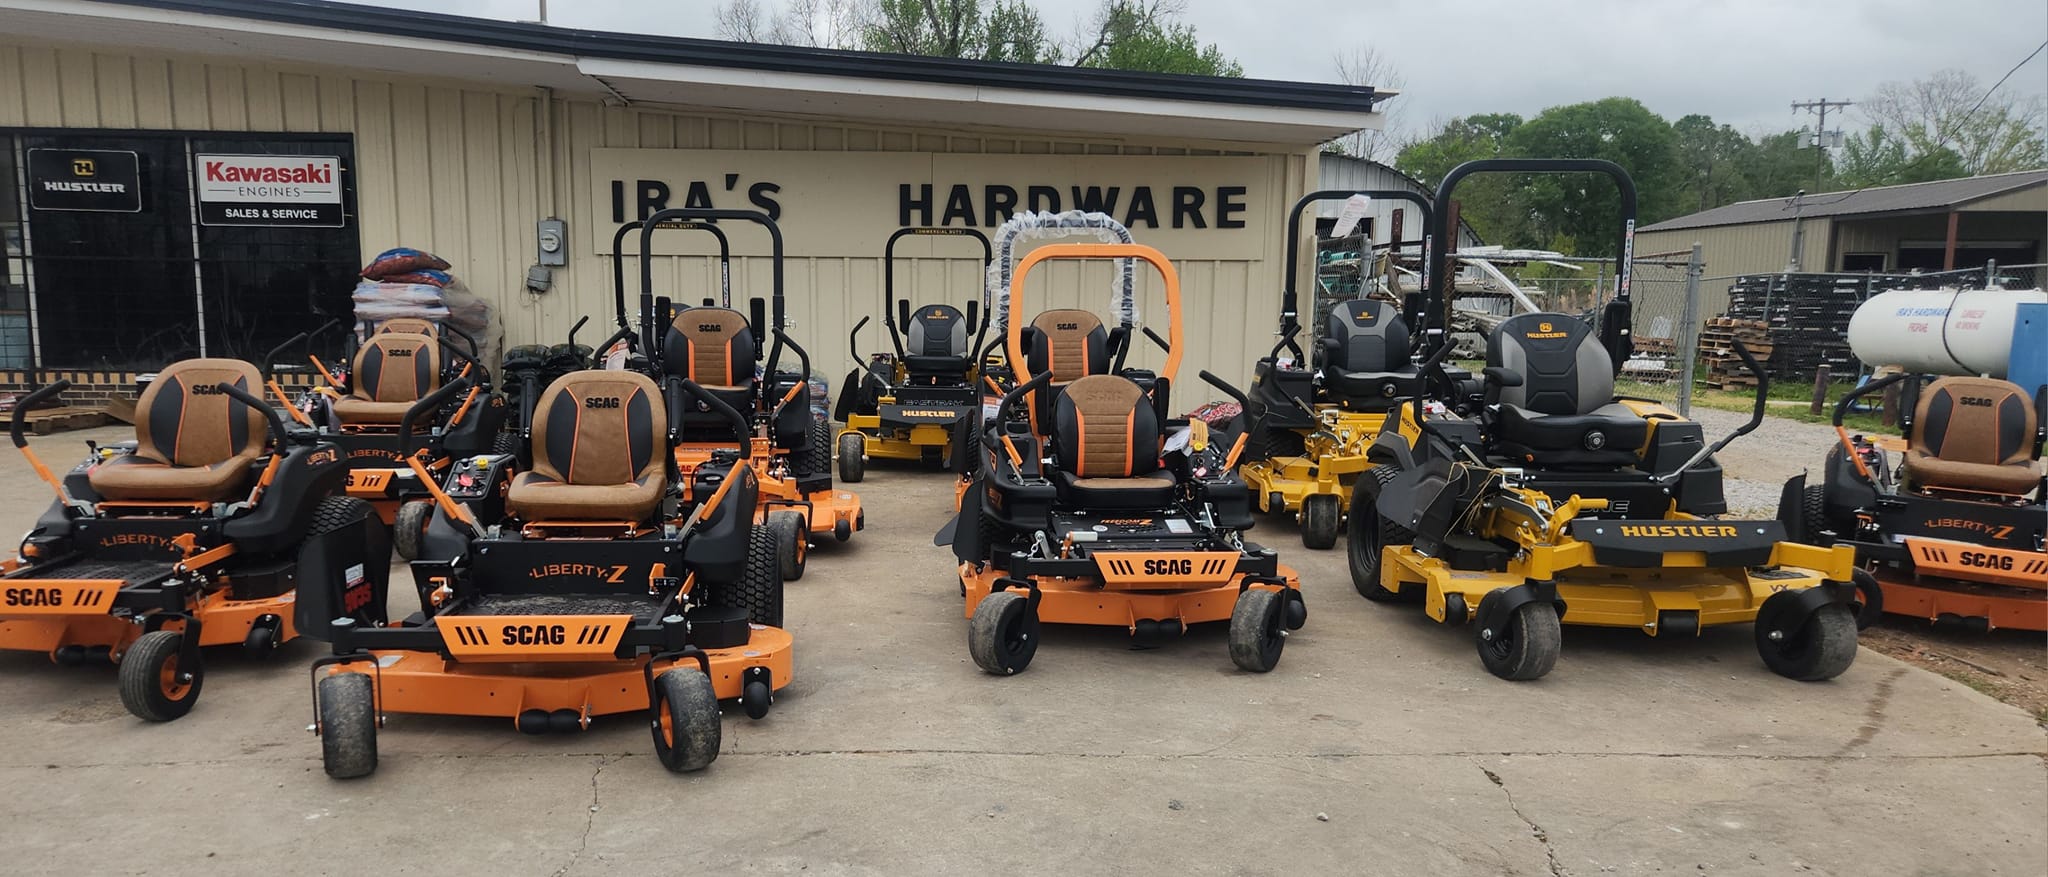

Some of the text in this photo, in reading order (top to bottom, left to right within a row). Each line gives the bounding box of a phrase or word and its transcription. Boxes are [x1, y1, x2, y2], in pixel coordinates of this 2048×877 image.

[206, 161, 331, 184] Kawasaki
[44, 181, 125, 193] HUSTLER
[238, 186, 301, 198] ENGINES
[612, 173, 1247, 229] IRA'S HARDWARE
[225, 208, 318, 219] SALES & SERVICE
[698, 323, 721, 332] SCAG
[1056, 322, 1078, 331] SCAG
[388, 348, 412, 357] SCAG
[585, 396, 620, 408] SCAG
[1960, 396, 1993, 407] SCAG
[902, 409, 956, 418] HUSTLER
[1620, 525, 1738, 537] HUSTLER
[1144, 559, 1192, 575] SCAG
[1959, 551, 2014, 571] SCAG
[5, 588, 62, 607] SCAG
[502, 625, 565, 645] SCAG
